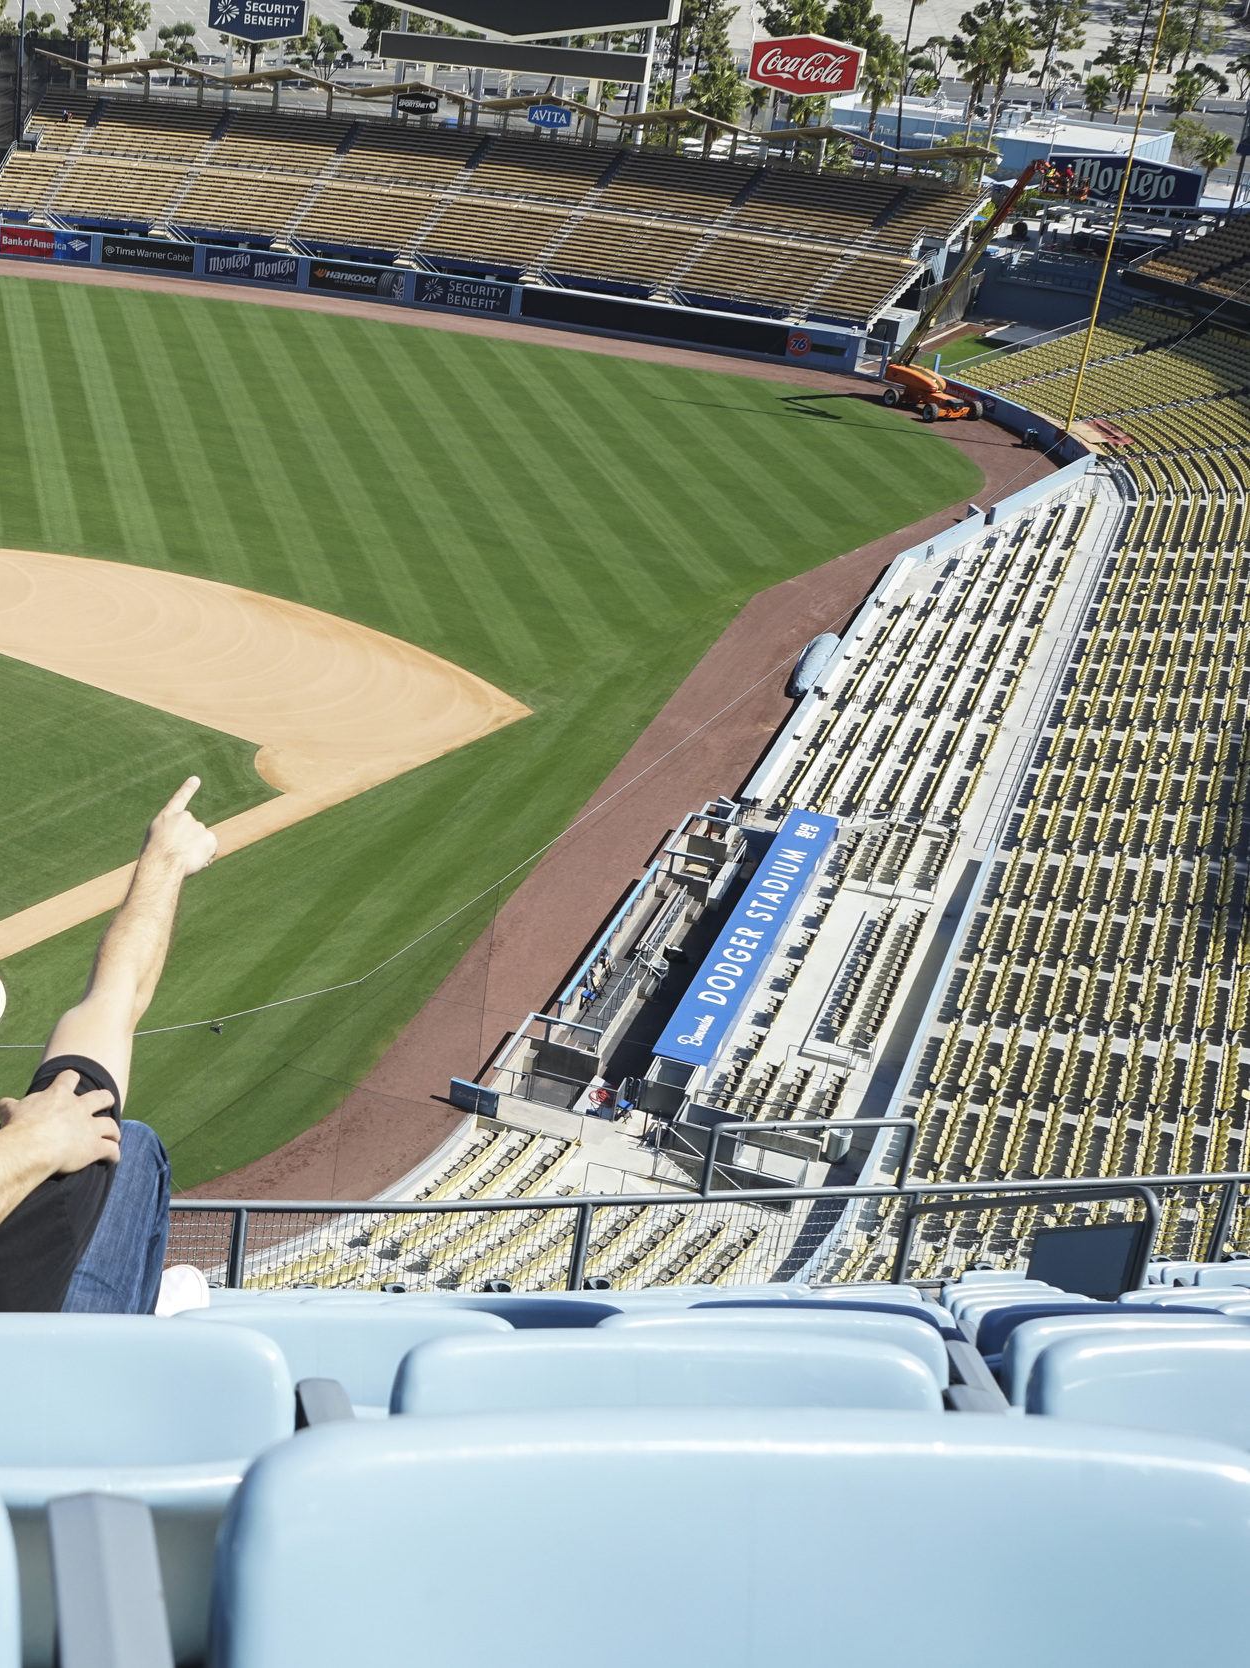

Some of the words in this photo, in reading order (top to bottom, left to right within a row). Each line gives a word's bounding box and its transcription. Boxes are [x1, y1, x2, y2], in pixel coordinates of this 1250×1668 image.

[245, 1, 299, 15] SECURITY
[243, 13, 291, 27] BENEFIT
[757, 48, 851, 84] Coca-Cola
[531, 110, 567, 123] AVITA
[2, 236, 22, 246] Bank
[23, 238, 32, 247] of
[33, 239, 66, 251] America
[115, 246, 135, 257] Time
[136, 248, 166, 260] Warner
[167, 251, 190, 262] Cable
[209, 253, 250, 273] Montejo
[254, 258, 296, 277] Montejo
[448, 280, 505, 298] SECURITY
[447, 293, 496, 310] BENEFIT
[789, 337, 808, 352] 76
[697, 926, 764, 1006] DODGER
[746, 848, 808, 922] STADIUM
